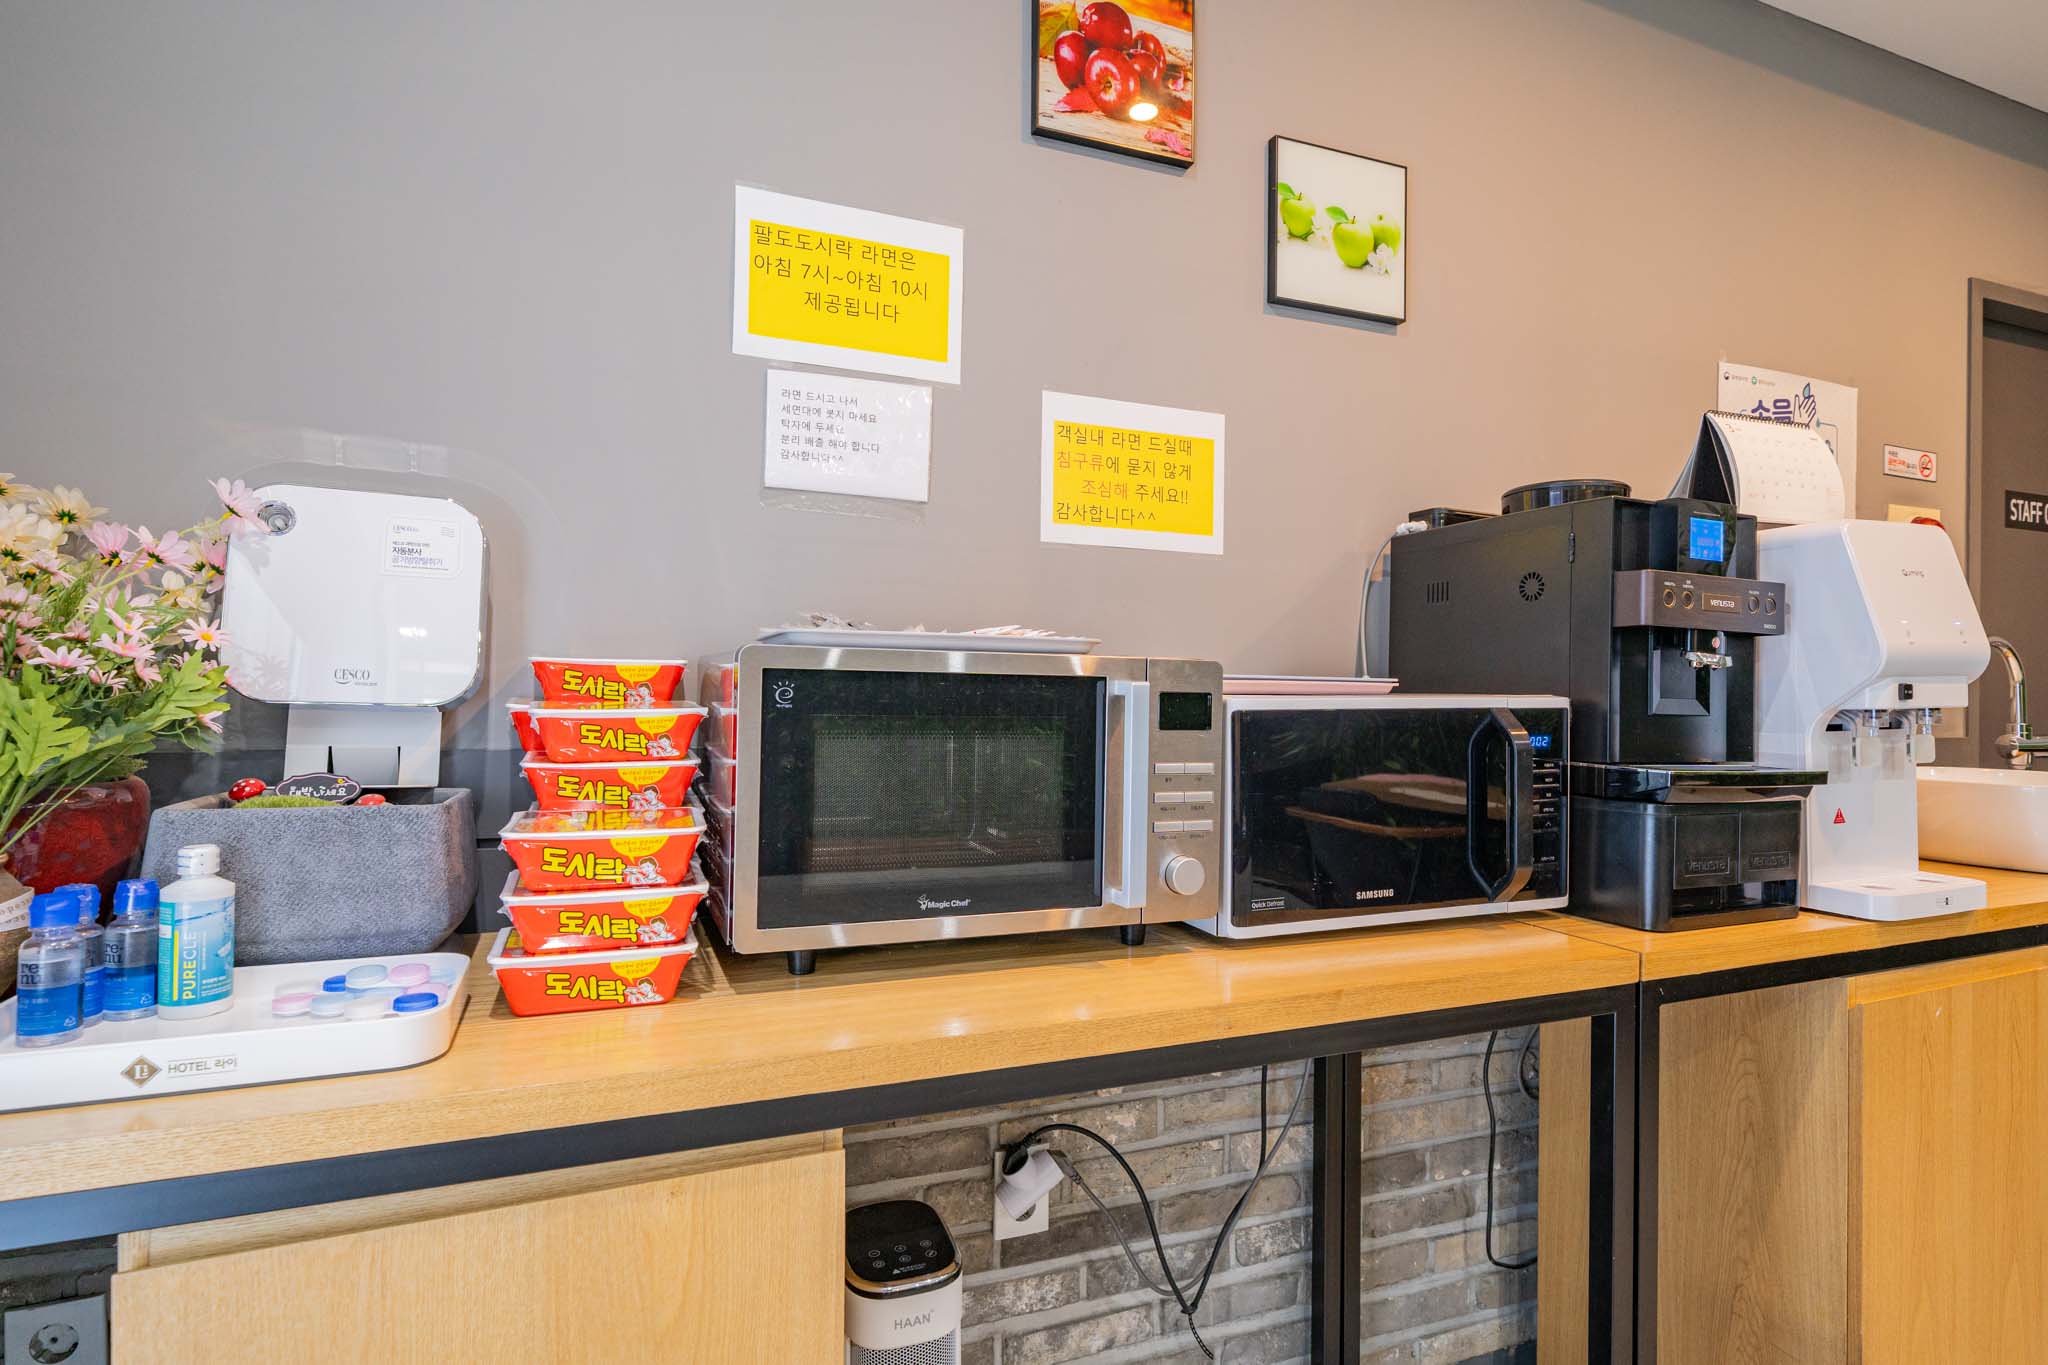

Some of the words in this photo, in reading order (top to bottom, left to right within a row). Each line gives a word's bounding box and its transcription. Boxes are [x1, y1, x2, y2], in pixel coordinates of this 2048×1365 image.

[754, 224, 853, 260] 팔도도시락
[861, 244, 916, 271] 라면은
[754, 254, 792, 278] 아침
[801, 263, 882, 294] 7시~아침
[891, 279, 928, 301] 10시
[804, 291, 900, 324] 제공됩니다
[781, 388, 801, 400] 라면
[806, 391, 836, 404] 드시고
[839, 395, 858, 407] 나서
[781, 404, 822, 417] 세면대에
[849, 411, 878, 424] 마세요
[781, 418, 811, 431] 탁자에
[780, 434, 801, 446] 분리
[851, 441, 880, 455] 합니다
[1057, 424, 1105, 447] 객실내
[1112, 431, 1142, 451] 라면
[1148, 436, 1193, 457] 드실때
[1057, 450, 1120, 474] 침구류에
[1127, 458, 1157, 478] 묻지
[1163, 461, 1193, 481] 않게
[1080, 479, 1129, 500] 조심해
[1135, 483, 1189, 504] 주세요!!
[1056, 502, 1157, 526] 감사합니다^^
[2010, 498, 2043, 524] STAFF
[334, 668, 371, 681] CESCO
[562, 669, 628, 702] 도시락
[580, 724, 650, 757] 도시락
[556, 774, 632, 809] 도시락
[541, 846, 627, 884] 도시락
[928, 900, 950, 909] Magic
[951, 899, 969, 907] Chef
[1251, 901, 1266, 909] Quick
[1356, 889, 1394, 900] SAMSUNG
[558, 911, 640, 943] 도시락
[182, 931, 197, 1000] PURECLE
[545, 972, 627, 1004] 도시락
[167, 1061, 211, 1074] HOTEL
[214, 1057, 238, 1069] 라이
[894, 1312, 931, 1331] HAAN
